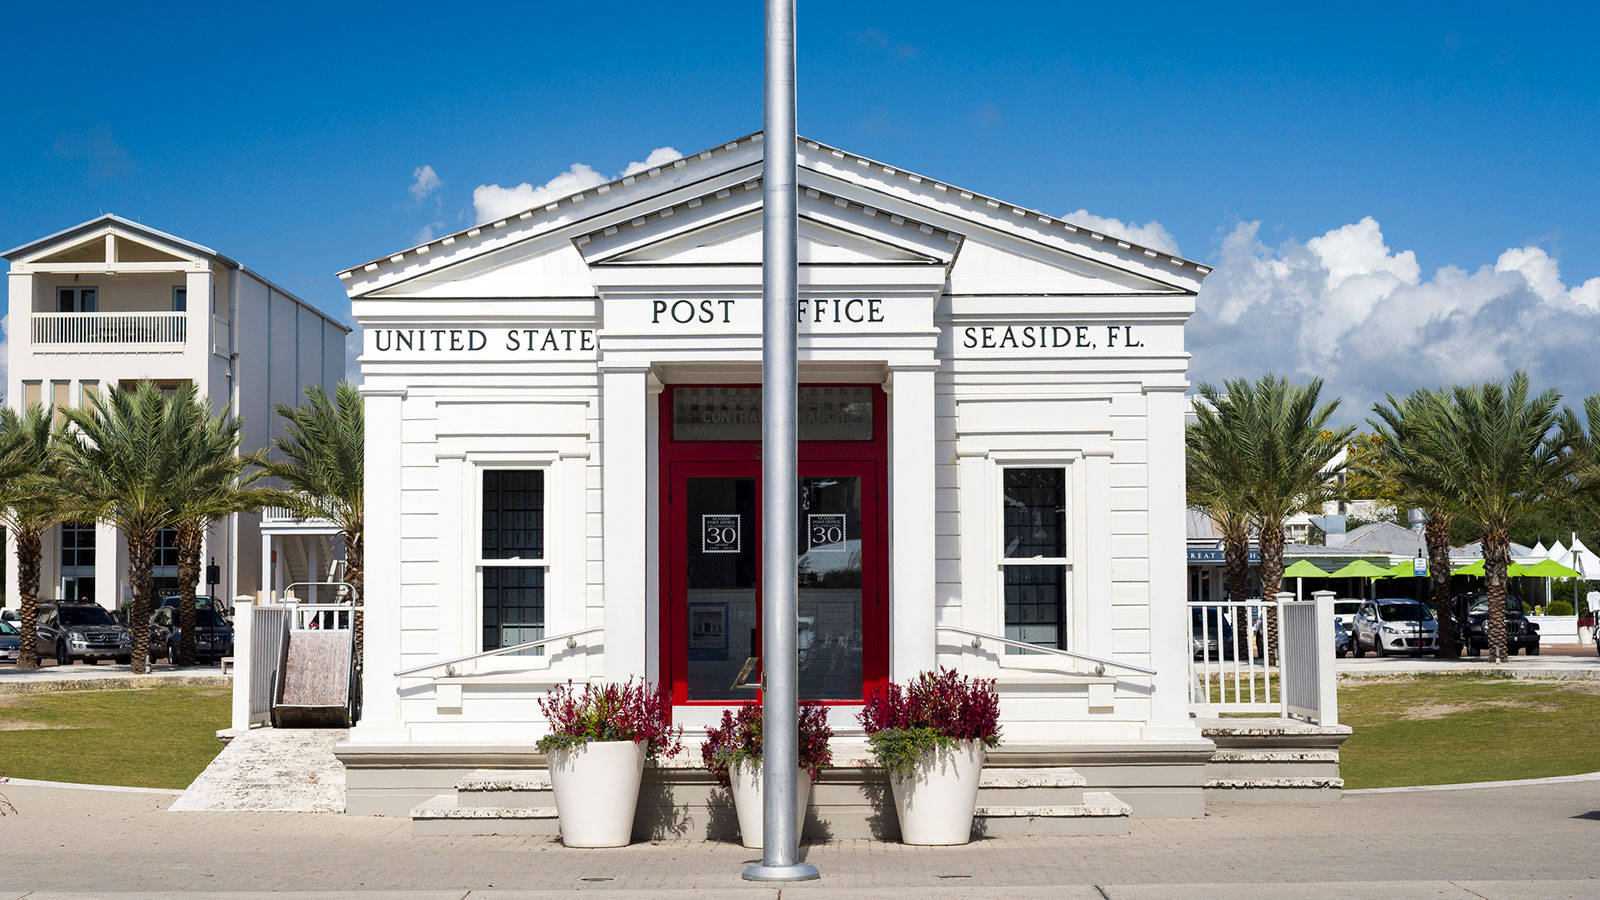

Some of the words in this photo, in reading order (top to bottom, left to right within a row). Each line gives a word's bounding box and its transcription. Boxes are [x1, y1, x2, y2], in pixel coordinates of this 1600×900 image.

[652, 300, 735, 324] POST
[797, 299, 885, 323] FFICE
[376, 329, 487, 352] UNITED
[507, 328, 599, 352] STATE
[964, 325, 1096, 350] SEASIDE,
[1107, 326, 1145, 348] FL.
[706, 527, 737, 544] 30
[812, 526, 842, 543] 30
